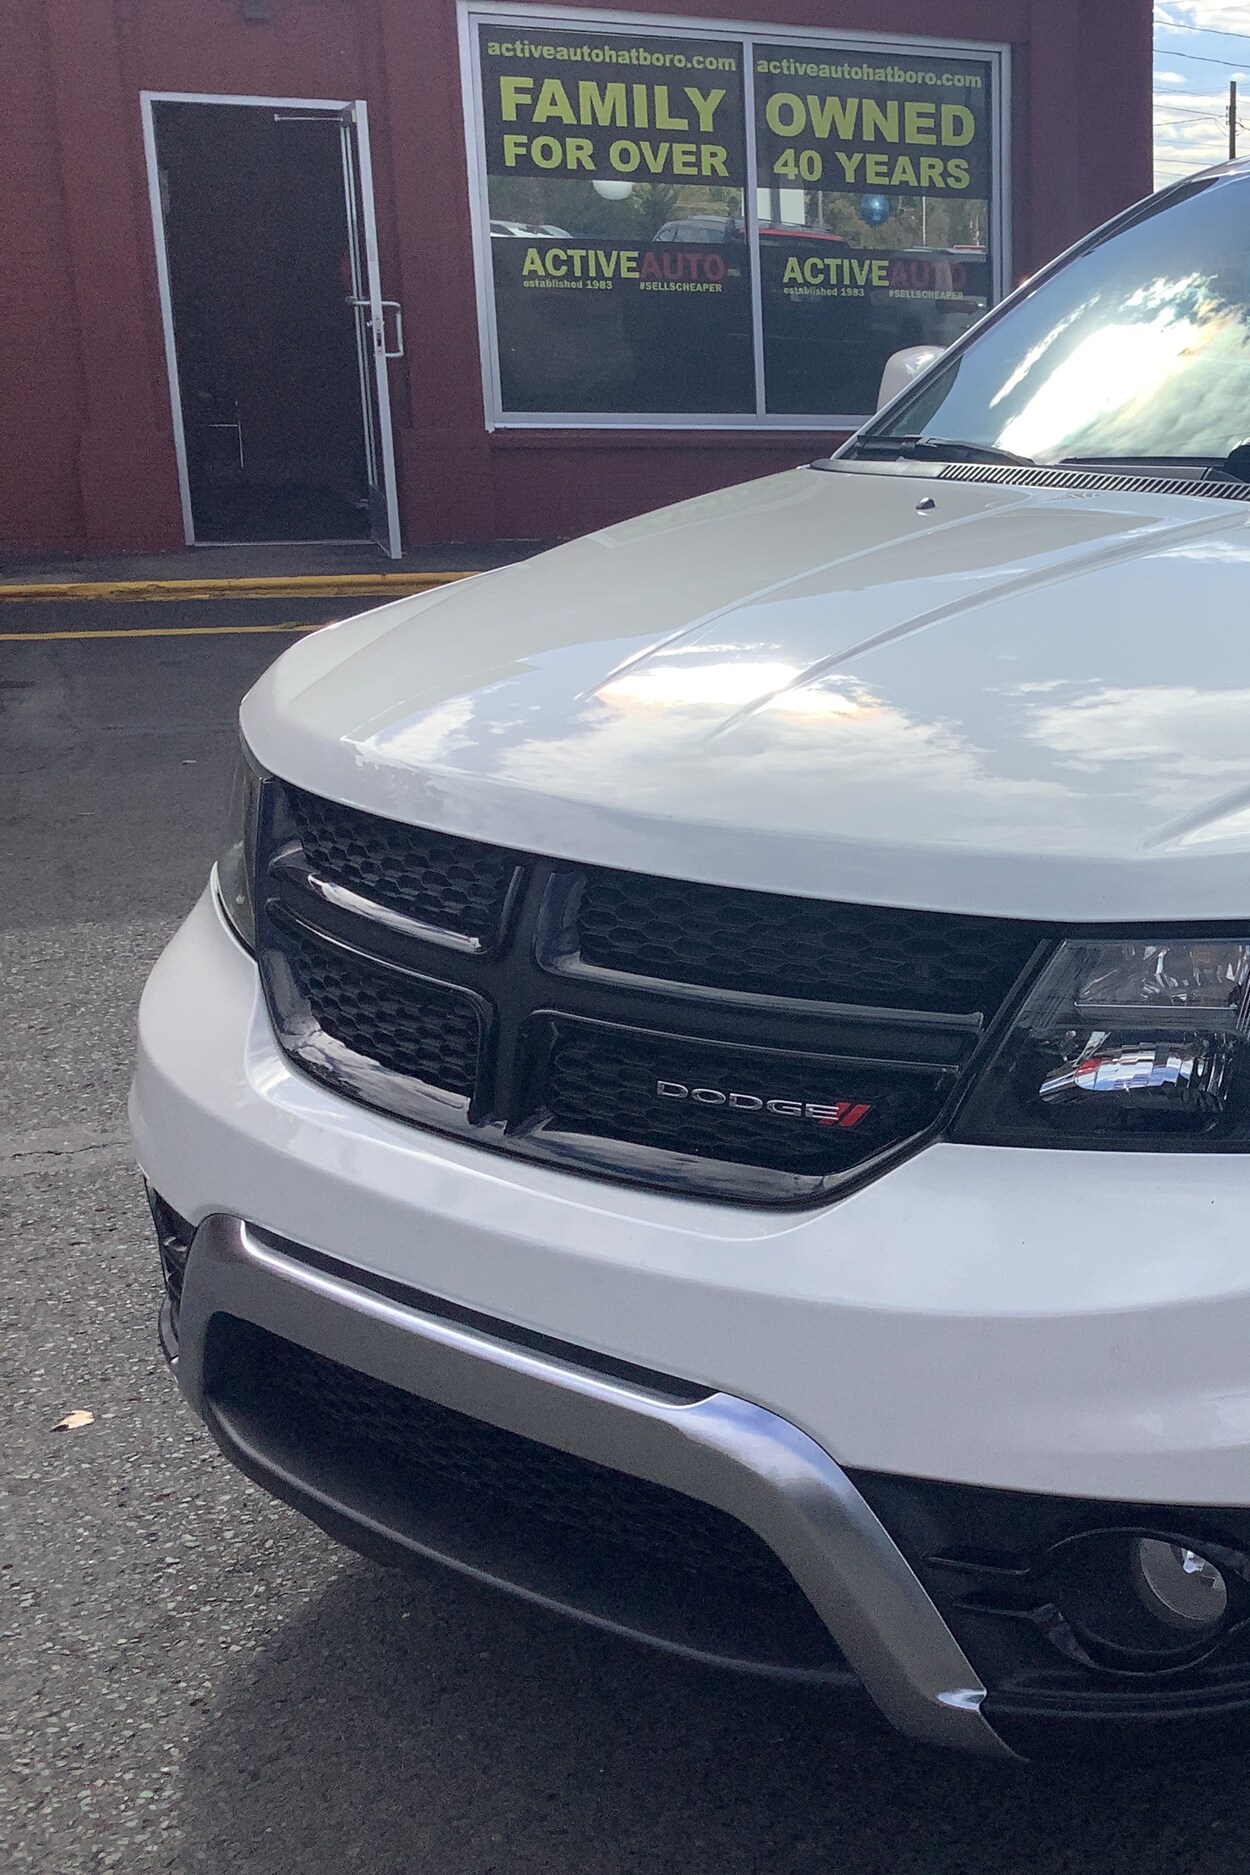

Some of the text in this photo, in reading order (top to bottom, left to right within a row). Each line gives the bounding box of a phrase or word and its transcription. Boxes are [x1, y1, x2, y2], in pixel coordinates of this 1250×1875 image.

[487, 40, 736, 71] activeautohatboro.com
[757, 58, 982, 88] activeautohatboro.com
[500, 75, 726, 132] FAMILY
[765, 92, 975, 147] OWNED
[503, 134, 729, 177] FOR OVER
[773, 149, 971, 189] 40 YEARS
[523, 279, 583, 289] established
[656, 1080, 839, 1121] DODGE
